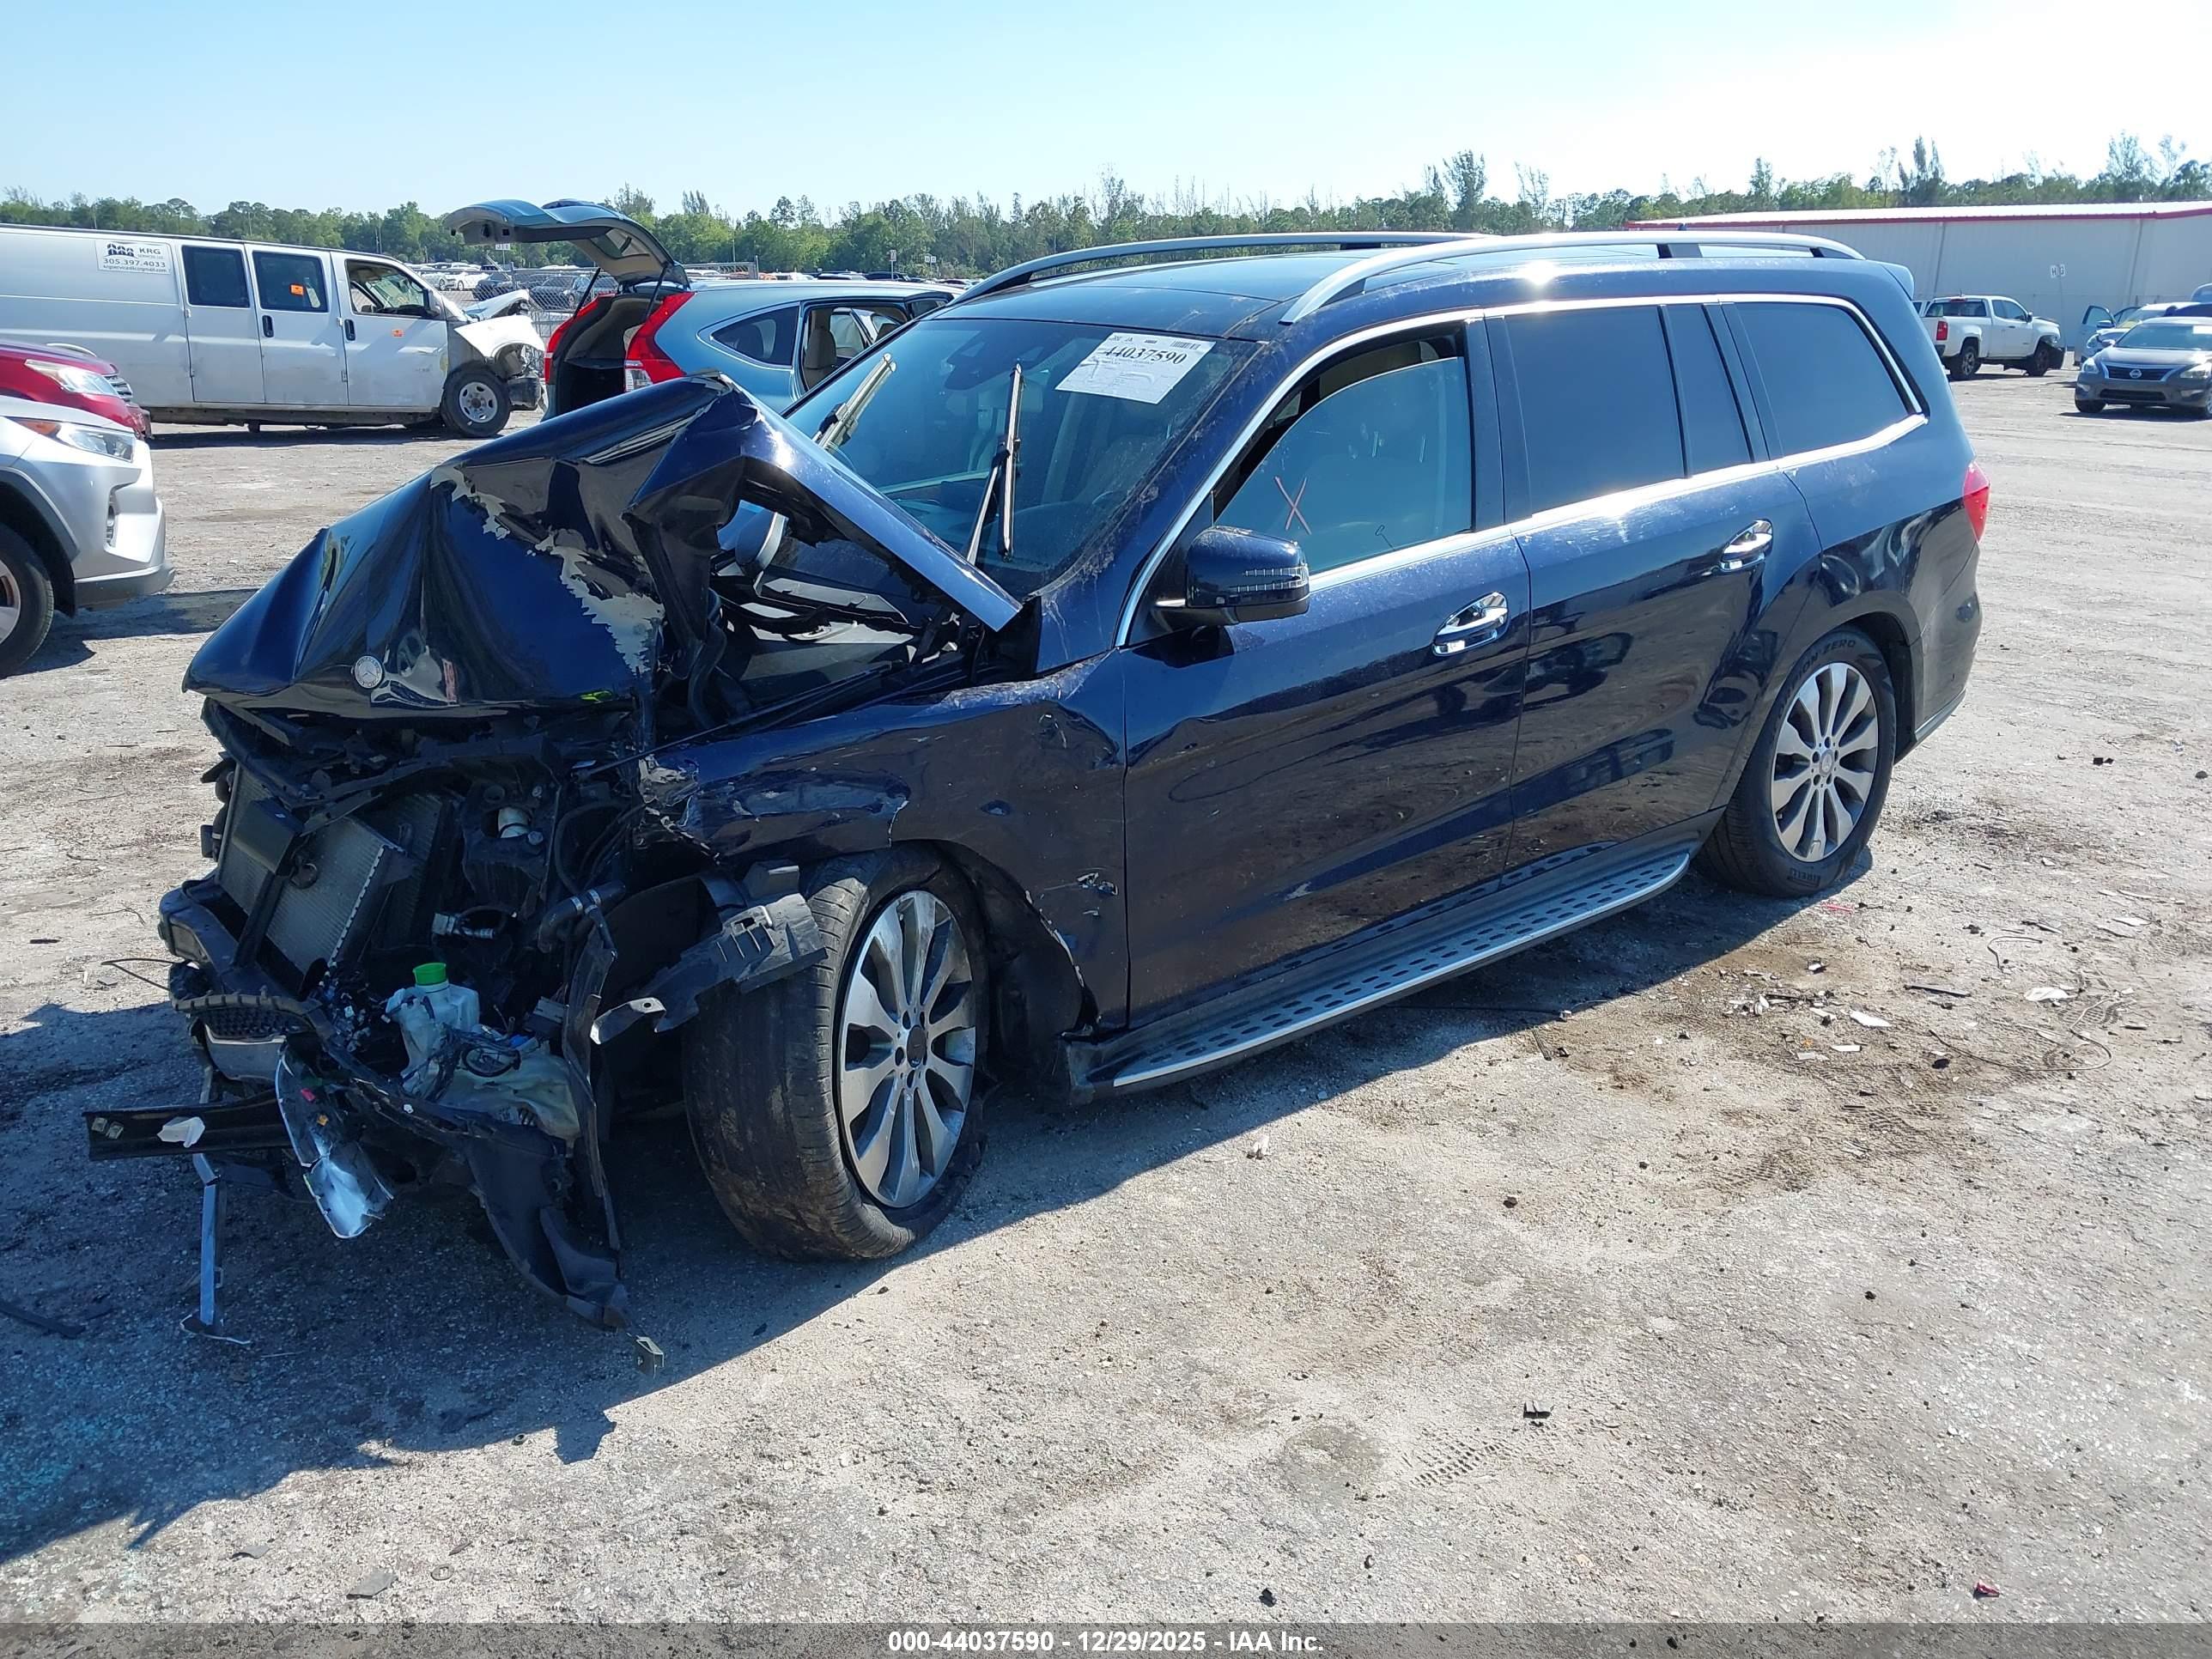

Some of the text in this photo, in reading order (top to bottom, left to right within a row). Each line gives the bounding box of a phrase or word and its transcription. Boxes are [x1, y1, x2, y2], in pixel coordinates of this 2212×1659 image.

[139, 246, 161, 255] KRG
[103, 258, 166, 268] 305.397.4033
[1105, 345, 1188, 365] 44037590
